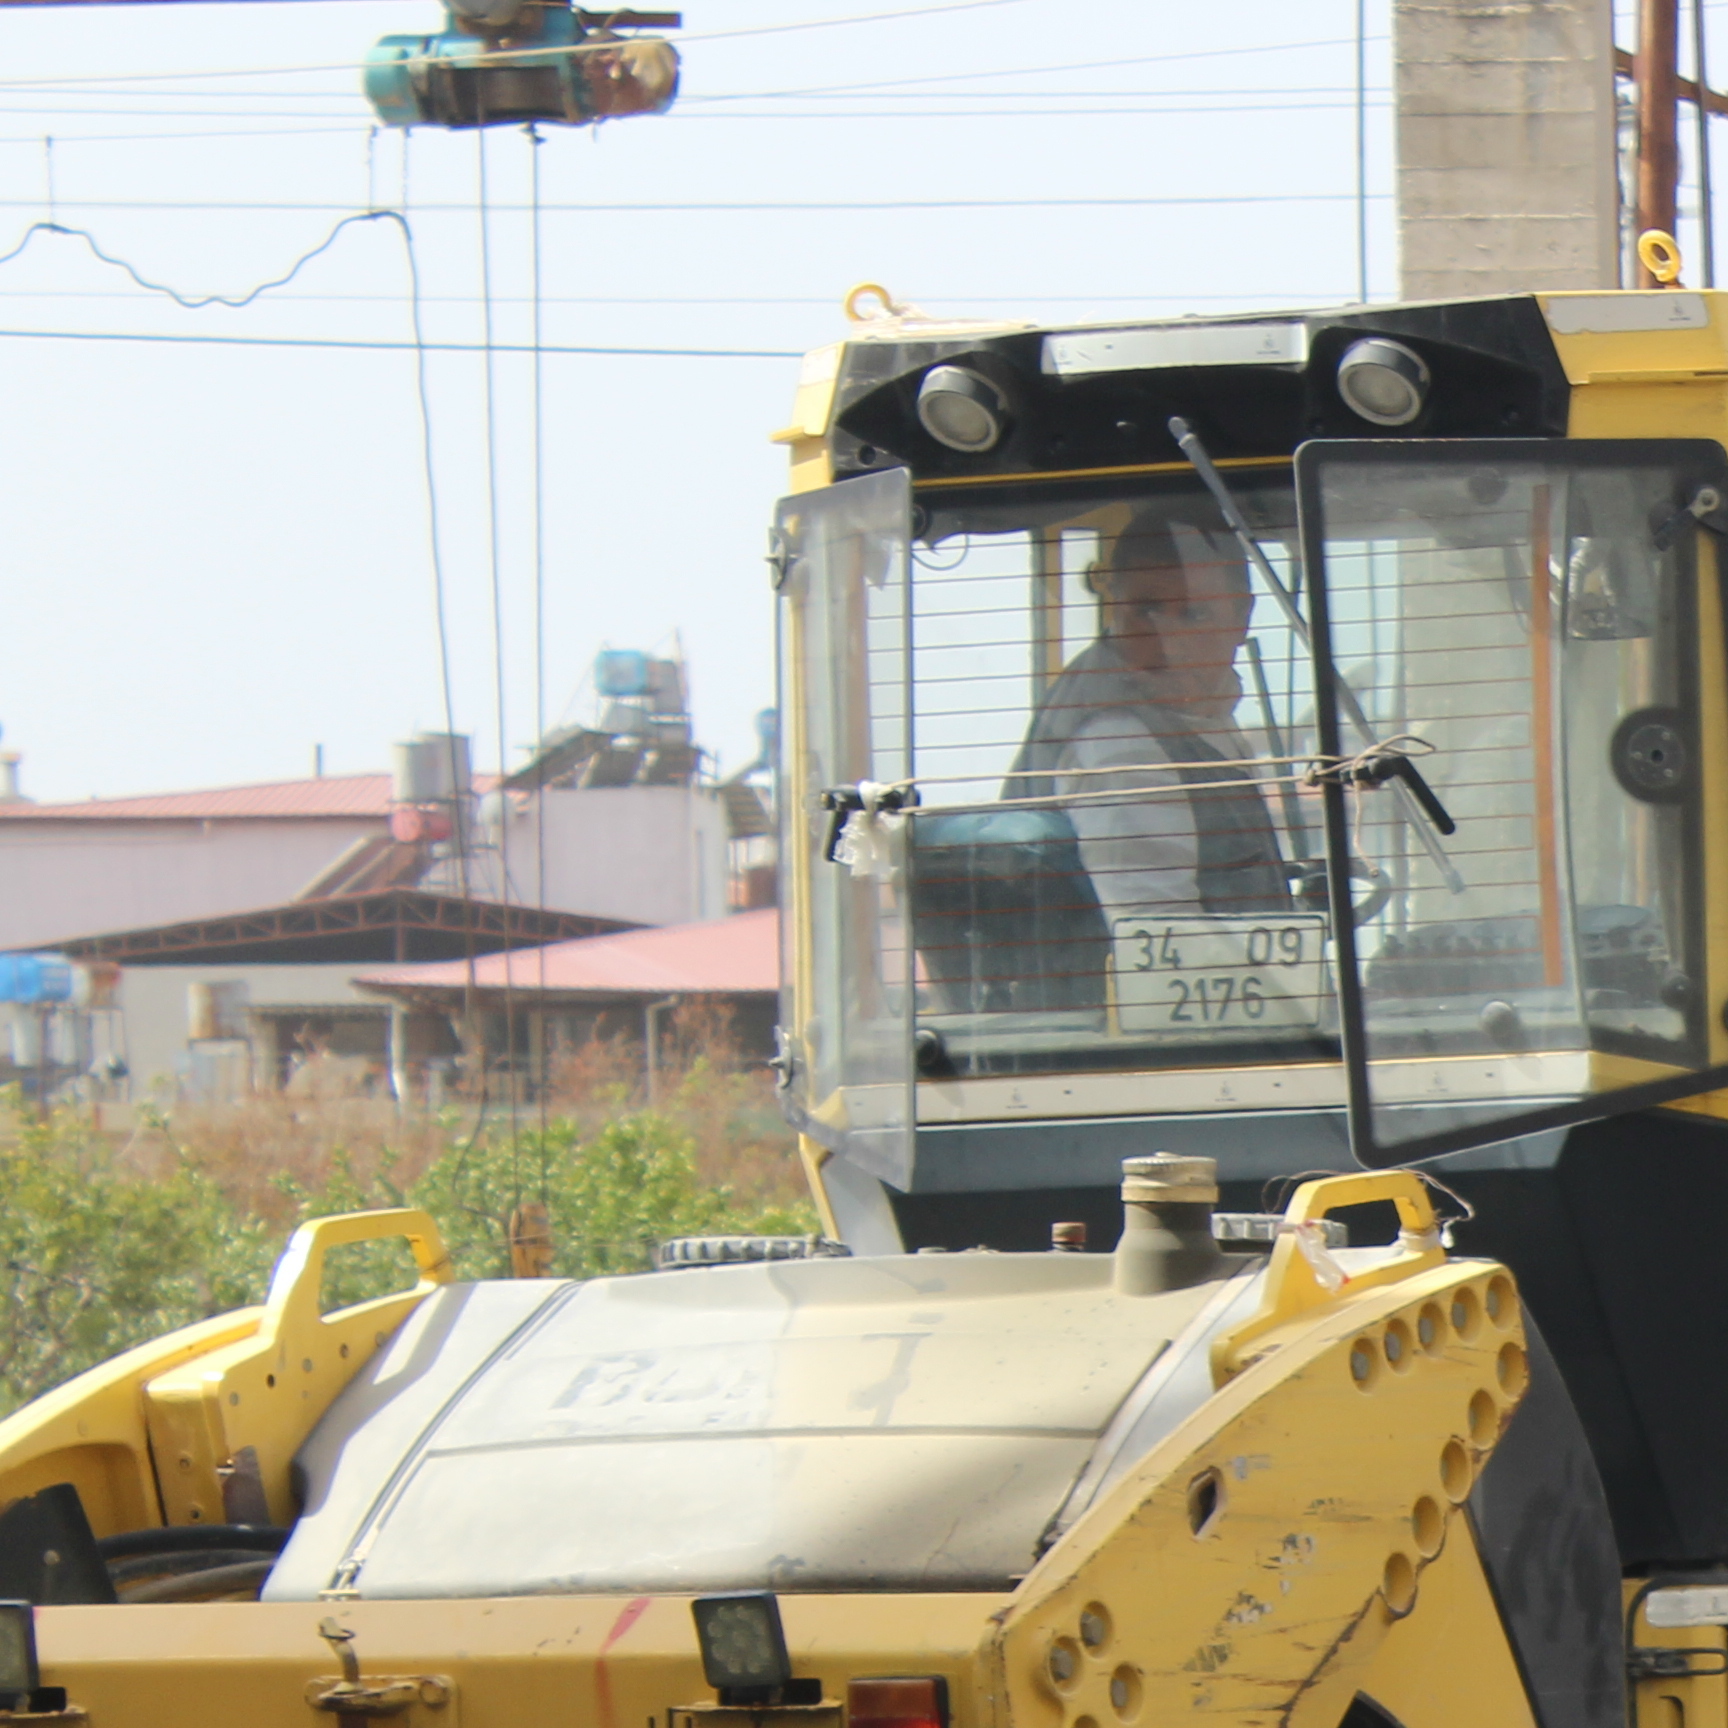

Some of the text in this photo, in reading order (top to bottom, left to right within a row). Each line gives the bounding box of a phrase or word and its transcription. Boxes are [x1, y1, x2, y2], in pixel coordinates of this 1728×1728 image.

[1133, 926, 1303, 971] 34 09
[1168, 976, 1265, 1022] 2176
